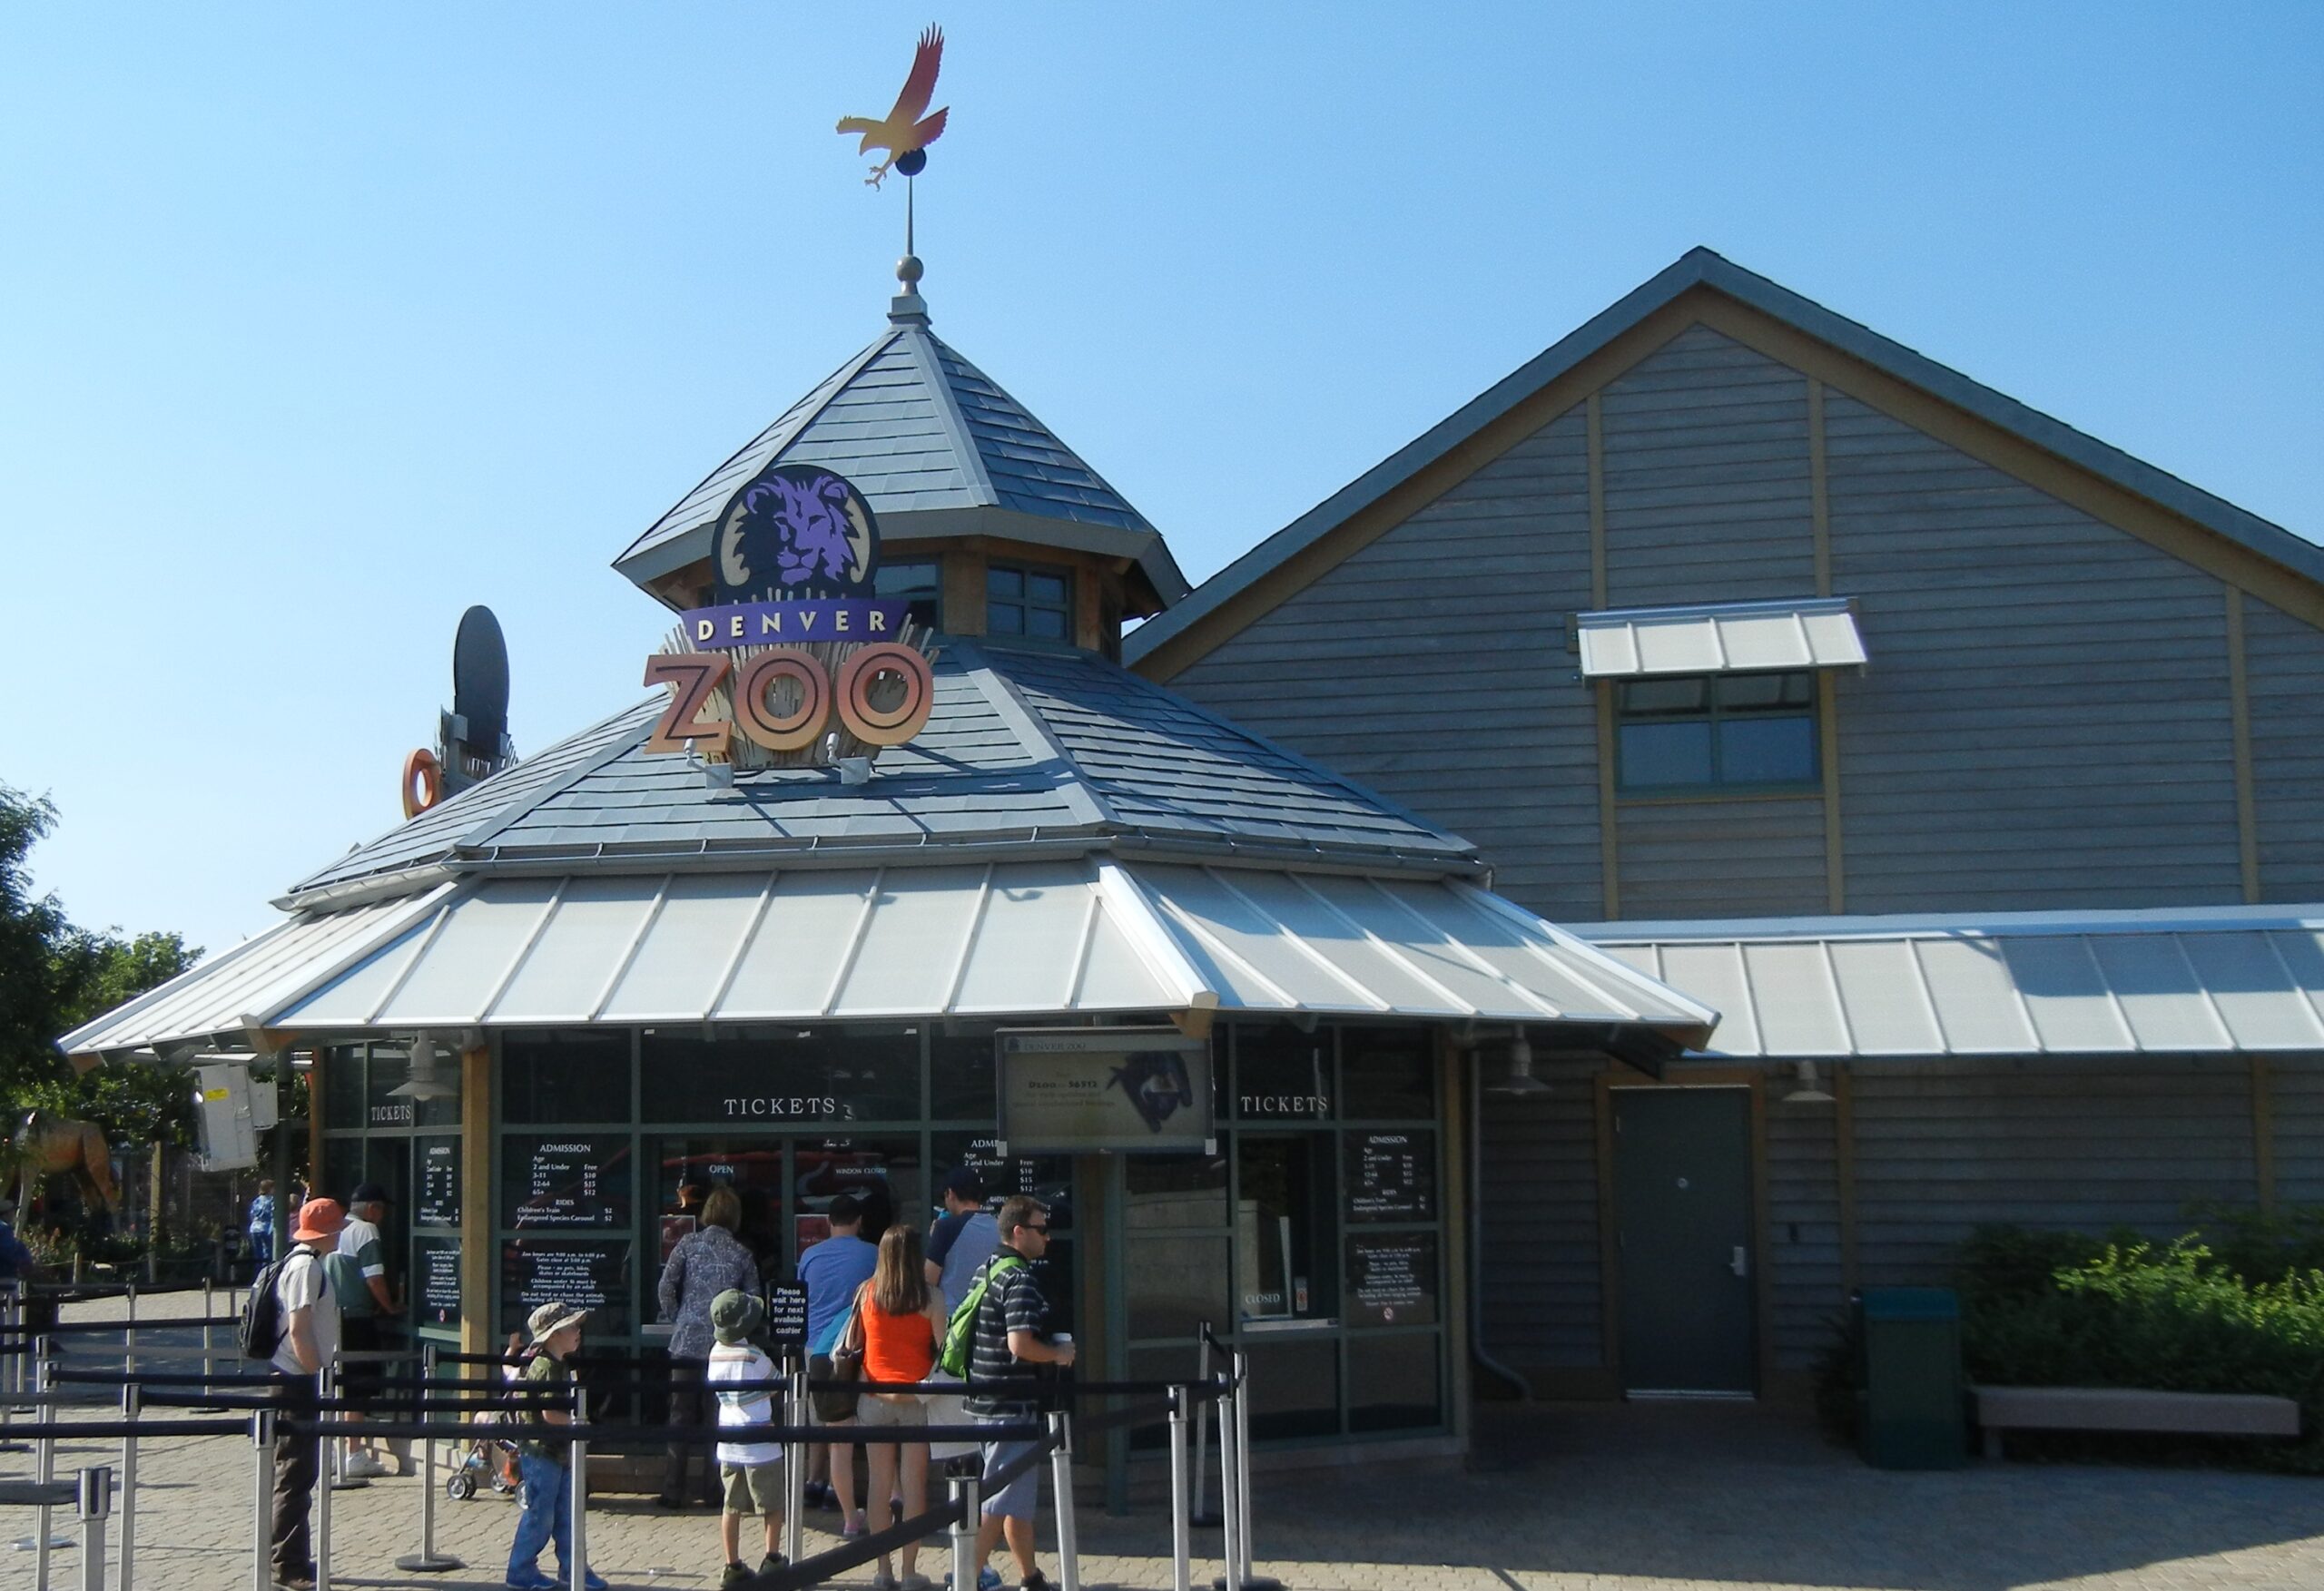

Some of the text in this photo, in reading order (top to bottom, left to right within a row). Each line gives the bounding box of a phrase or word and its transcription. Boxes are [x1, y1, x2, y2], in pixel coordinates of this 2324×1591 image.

[697, 610, 886, 642] DENVER
[643, 642, 935, 755] ZOO
[724, 1097, 836, 1115] TICKETS
[1240, 1095, 1328, 1112] TICKETS
[371, 1105, 411, 1121] TICKETS
[1368, 1135, 1408, 1144] ADMISSION
[539, 1144, 592, 1153] ADMISSION
[964, 1152, 977, 1160] Age
[708, 1164, 734, 1174] OPEN
[776, 1287, 801, 1295] Please
[1245, 1292, 1281, 1304] CLOSED
[773, 1305, 784, 1313] for
[773, 1315, 804, 1323] available
[775, 1326, 802, 1334] cashier
